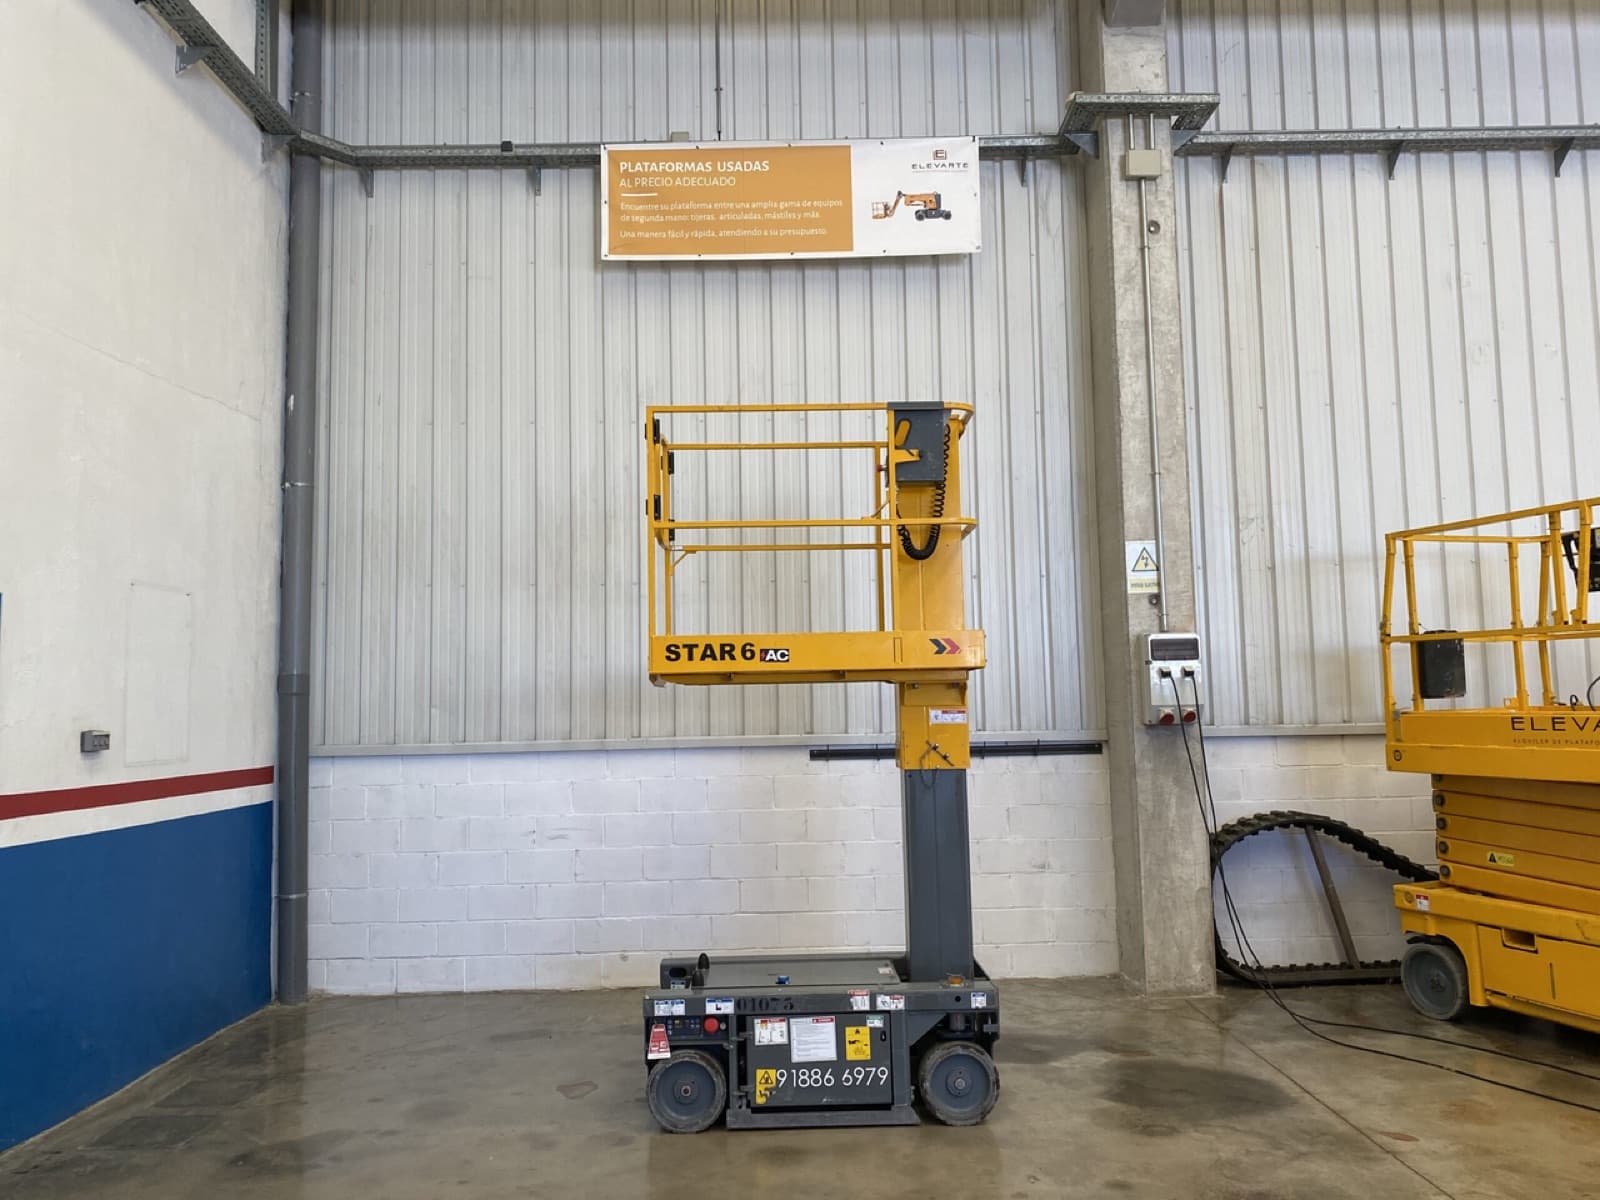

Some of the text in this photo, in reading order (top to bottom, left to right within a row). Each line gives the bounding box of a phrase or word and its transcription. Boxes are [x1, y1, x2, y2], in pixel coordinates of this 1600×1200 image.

[619, 160, 770, 173] PLATAFORMAS USADAS
[911, 162, 969, 170] ELEVARTE
[619, 176, 737, 188] AL PRECIO ADECUADO
[620, 201, 659, 211] Encuentre
[660, 202, 669, 210] su
[670, 200, 712, 211] plataforma
[713, 201, 735, 209] entre
[751, 200, 778, 210] amplia
[779, 201, 801, 210] gama
[802, 200, 812, 208] de
[813, 199, 843, 209] equipos
[621, 213, 631, 221] de
[631, 214, 665, 224] segunda
[620, 230, 635, 239] Una
[637, 231, 667, 239] manera
[719, 228, 762, 238] atendiendo
[665, 643, 789, 662] STAR 6 AC
[841, 1066, 889, 1087] 6979
